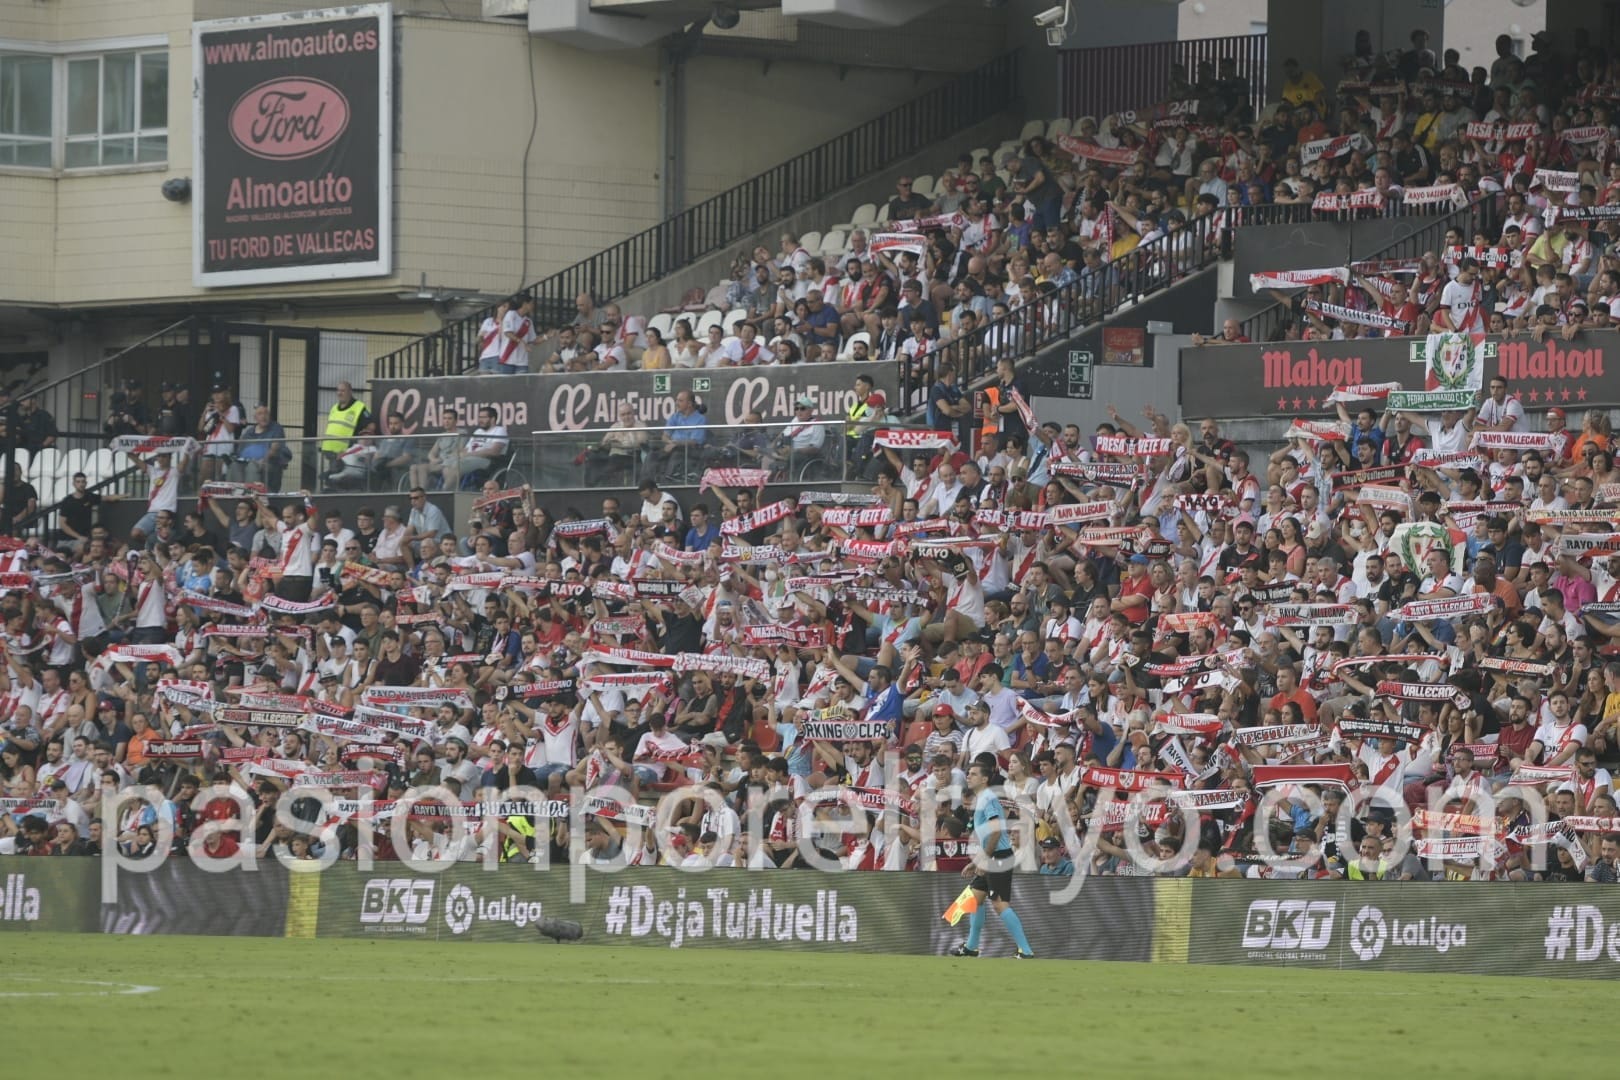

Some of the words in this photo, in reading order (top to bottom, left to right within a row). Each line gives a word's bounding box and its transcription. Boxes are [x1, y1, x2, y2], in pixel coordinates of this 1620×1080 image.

[205, 29, 378, 64] www.almoauto.es
[251, 91, 326, 145] Ford
[227, 172, 353, 210] Almoauto
[209, 239, 226, 262] TU
[231, 236, 270, 259] FORD
[273, 234, 293, 256] DE
[297, 227, 376, 254] VALLECAS
[1498, 339, 1604, 380] Mahou
[1262, 348, 1363, 388] Mahou
[1407, 393, 1425, 405] PEDRO
[1095, 437, 1125, 453] PRESA
[1482, 433, 1502, 444] RAYO
[1503, 434, 1547, 446] VALLECANO
[1185, 496, 1219, 507] RAYO
[822, 509, 849, 523] PRESA
[918, 546, 949, 559] RAYO
[1566, 539, 1593, 551] RAYO
[550, 582, 585, 596] RAYO
[1279, 606, 1296, 618] RAYO
[1411, 605, 1430, 616] RAYO
[1432, 602, 1474, 614] VALLECANO
[610, 648, 628, 658] RAYO
[513, 684, 532, 694] RAYO
[533, 680, 572, 692] VALLECANO
[369, 689, 397, 699] RAYO
[398, 690, 458, 702] VALLECANO
[251, 712, 297, 724] VALLECANO
[1092, 770, 1115, 785] Rayo
[414, 804, 436, 816] RAYO
[481, 800, 569, 817] BUKANEROS
[0, 873, 41, 921] lla
[363, 882, 434, 920] BKT
[479, 895, 543, 928] LaLiga
[606, 886, 858, 949] #DejaTuHuella
[1244, 904, 1335, 946] BKT
[1392, 917, 1467, 953] LaLiga
